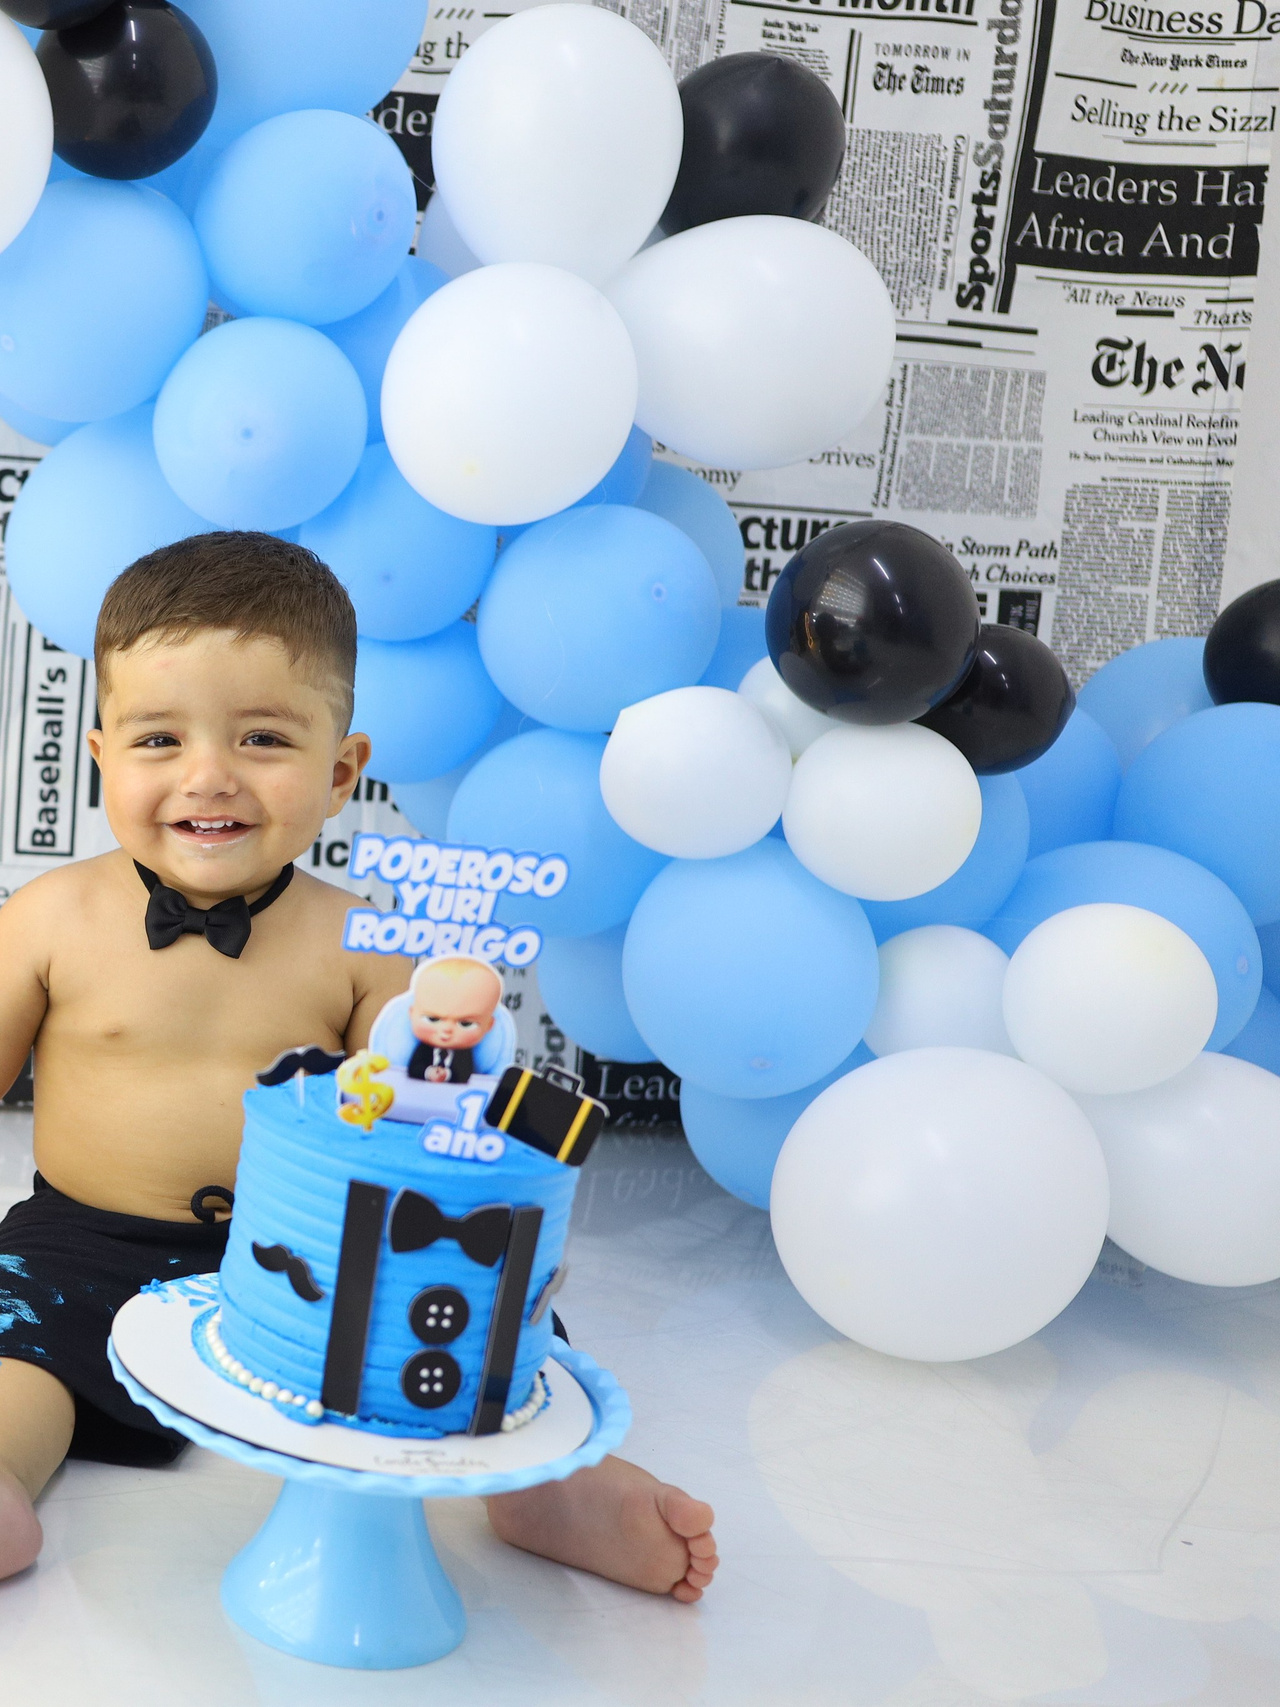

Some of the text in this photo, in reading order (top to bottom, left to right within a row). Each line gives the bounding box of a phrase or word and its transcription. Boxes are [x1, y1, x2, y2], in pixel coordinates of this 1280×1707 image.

[875, 42, 971, 61] TOMORROW IN
[1205, 54, 1248, 69] Times
[873, 60, 965, 96] The Times
[1071, 94, 1149, 136] Selling
[1158, 105, 1201, 131] the
[1032, 157, 1178, 206] Leaders
[1014, 211, 1235, 260] Africa And
[1095, 290, 1125, 306] the
[1131, 291, 1186, 309] News
[1091, 335, 1186, 396] The
[1073, 408, 1125, 429] Leading
[1128, 411, 1182, 429] Cardinal
[1151, 430, 1184, 447] View
[1186, 436, 1204, 447] on
[958, 535, 1011, 557] Storm
[1015, 539, 1058, 559] Path
[986, 562, 1057, 584] Choices
[31, 665, 67, 848] Baseball's
[350, 835, 570, 899] PODEROSO
[396, 880, 499, 926] YURI
[344, 910, 542, 968] RODRIGO
[458, 1091, 487, 1132] 1
[422, 1122, 508, 1163] ano
